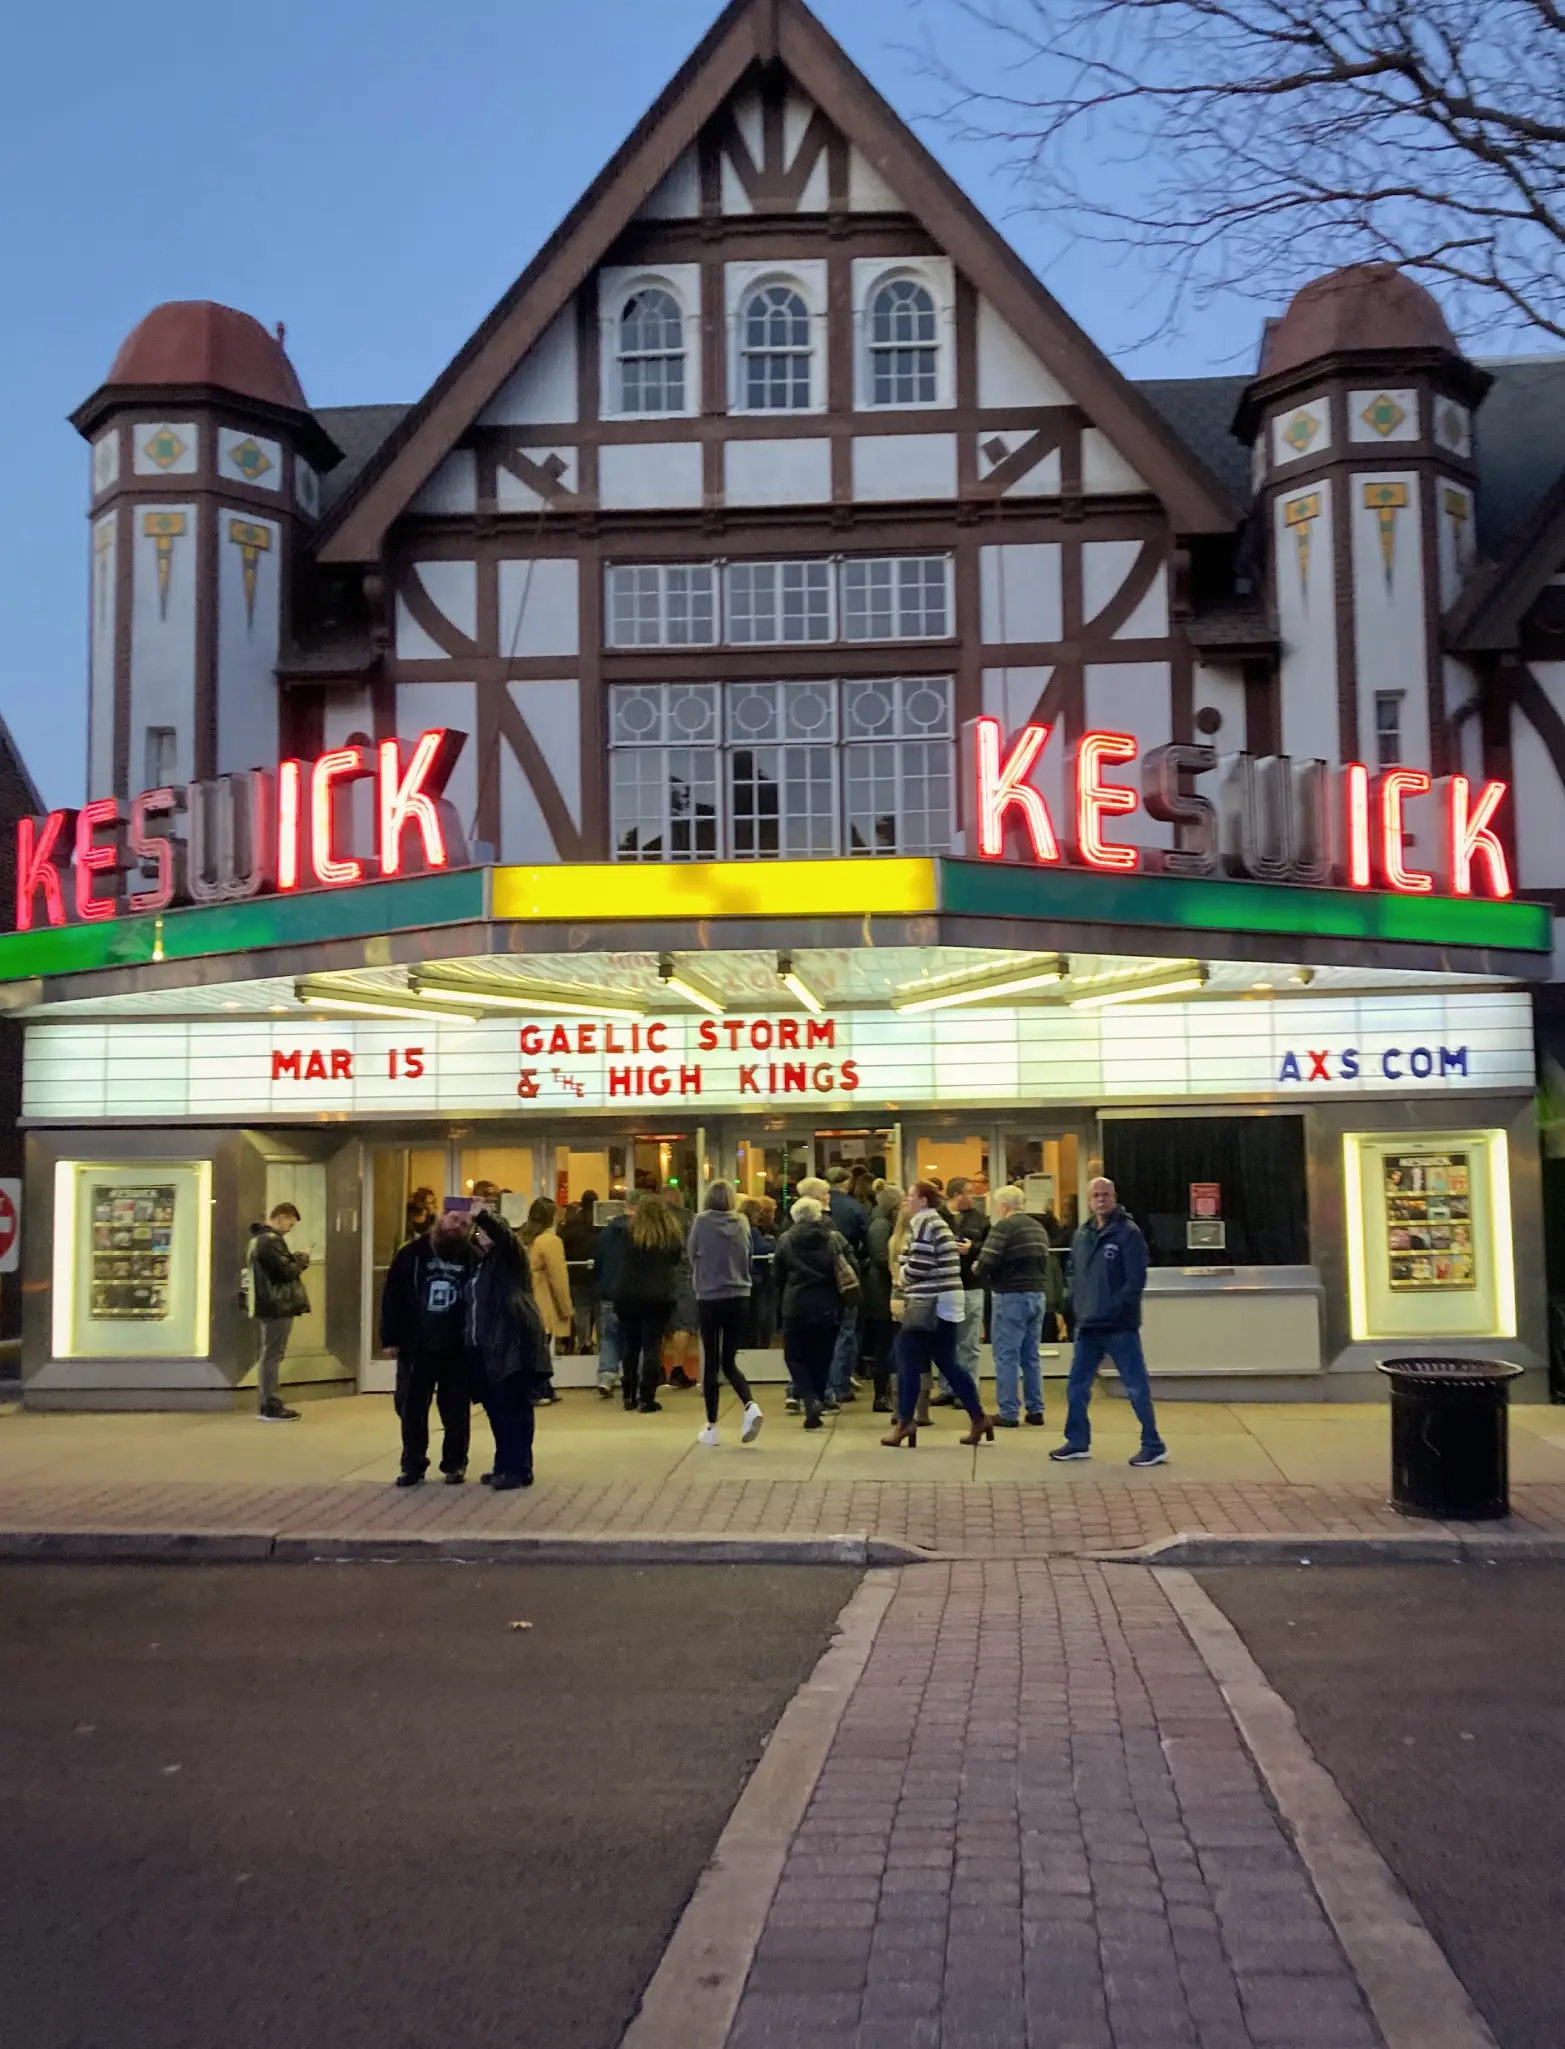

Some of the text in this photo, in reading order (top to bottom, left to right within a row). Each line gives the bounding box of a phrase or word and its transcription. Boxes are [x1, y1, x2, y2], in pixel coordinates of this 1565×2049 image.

[976, 715, 1511, 898] KESWICK
[16, 727, 448, 931] KESWICK
[519, 1018, 836, 1055] GAELIC STORM
[271, 1047, 425, 1080] MAR 15
[517, 1060, 860, 1099] & THE HIGH KINGS
[1278, 1045, 1469, 1082] AXS COM
